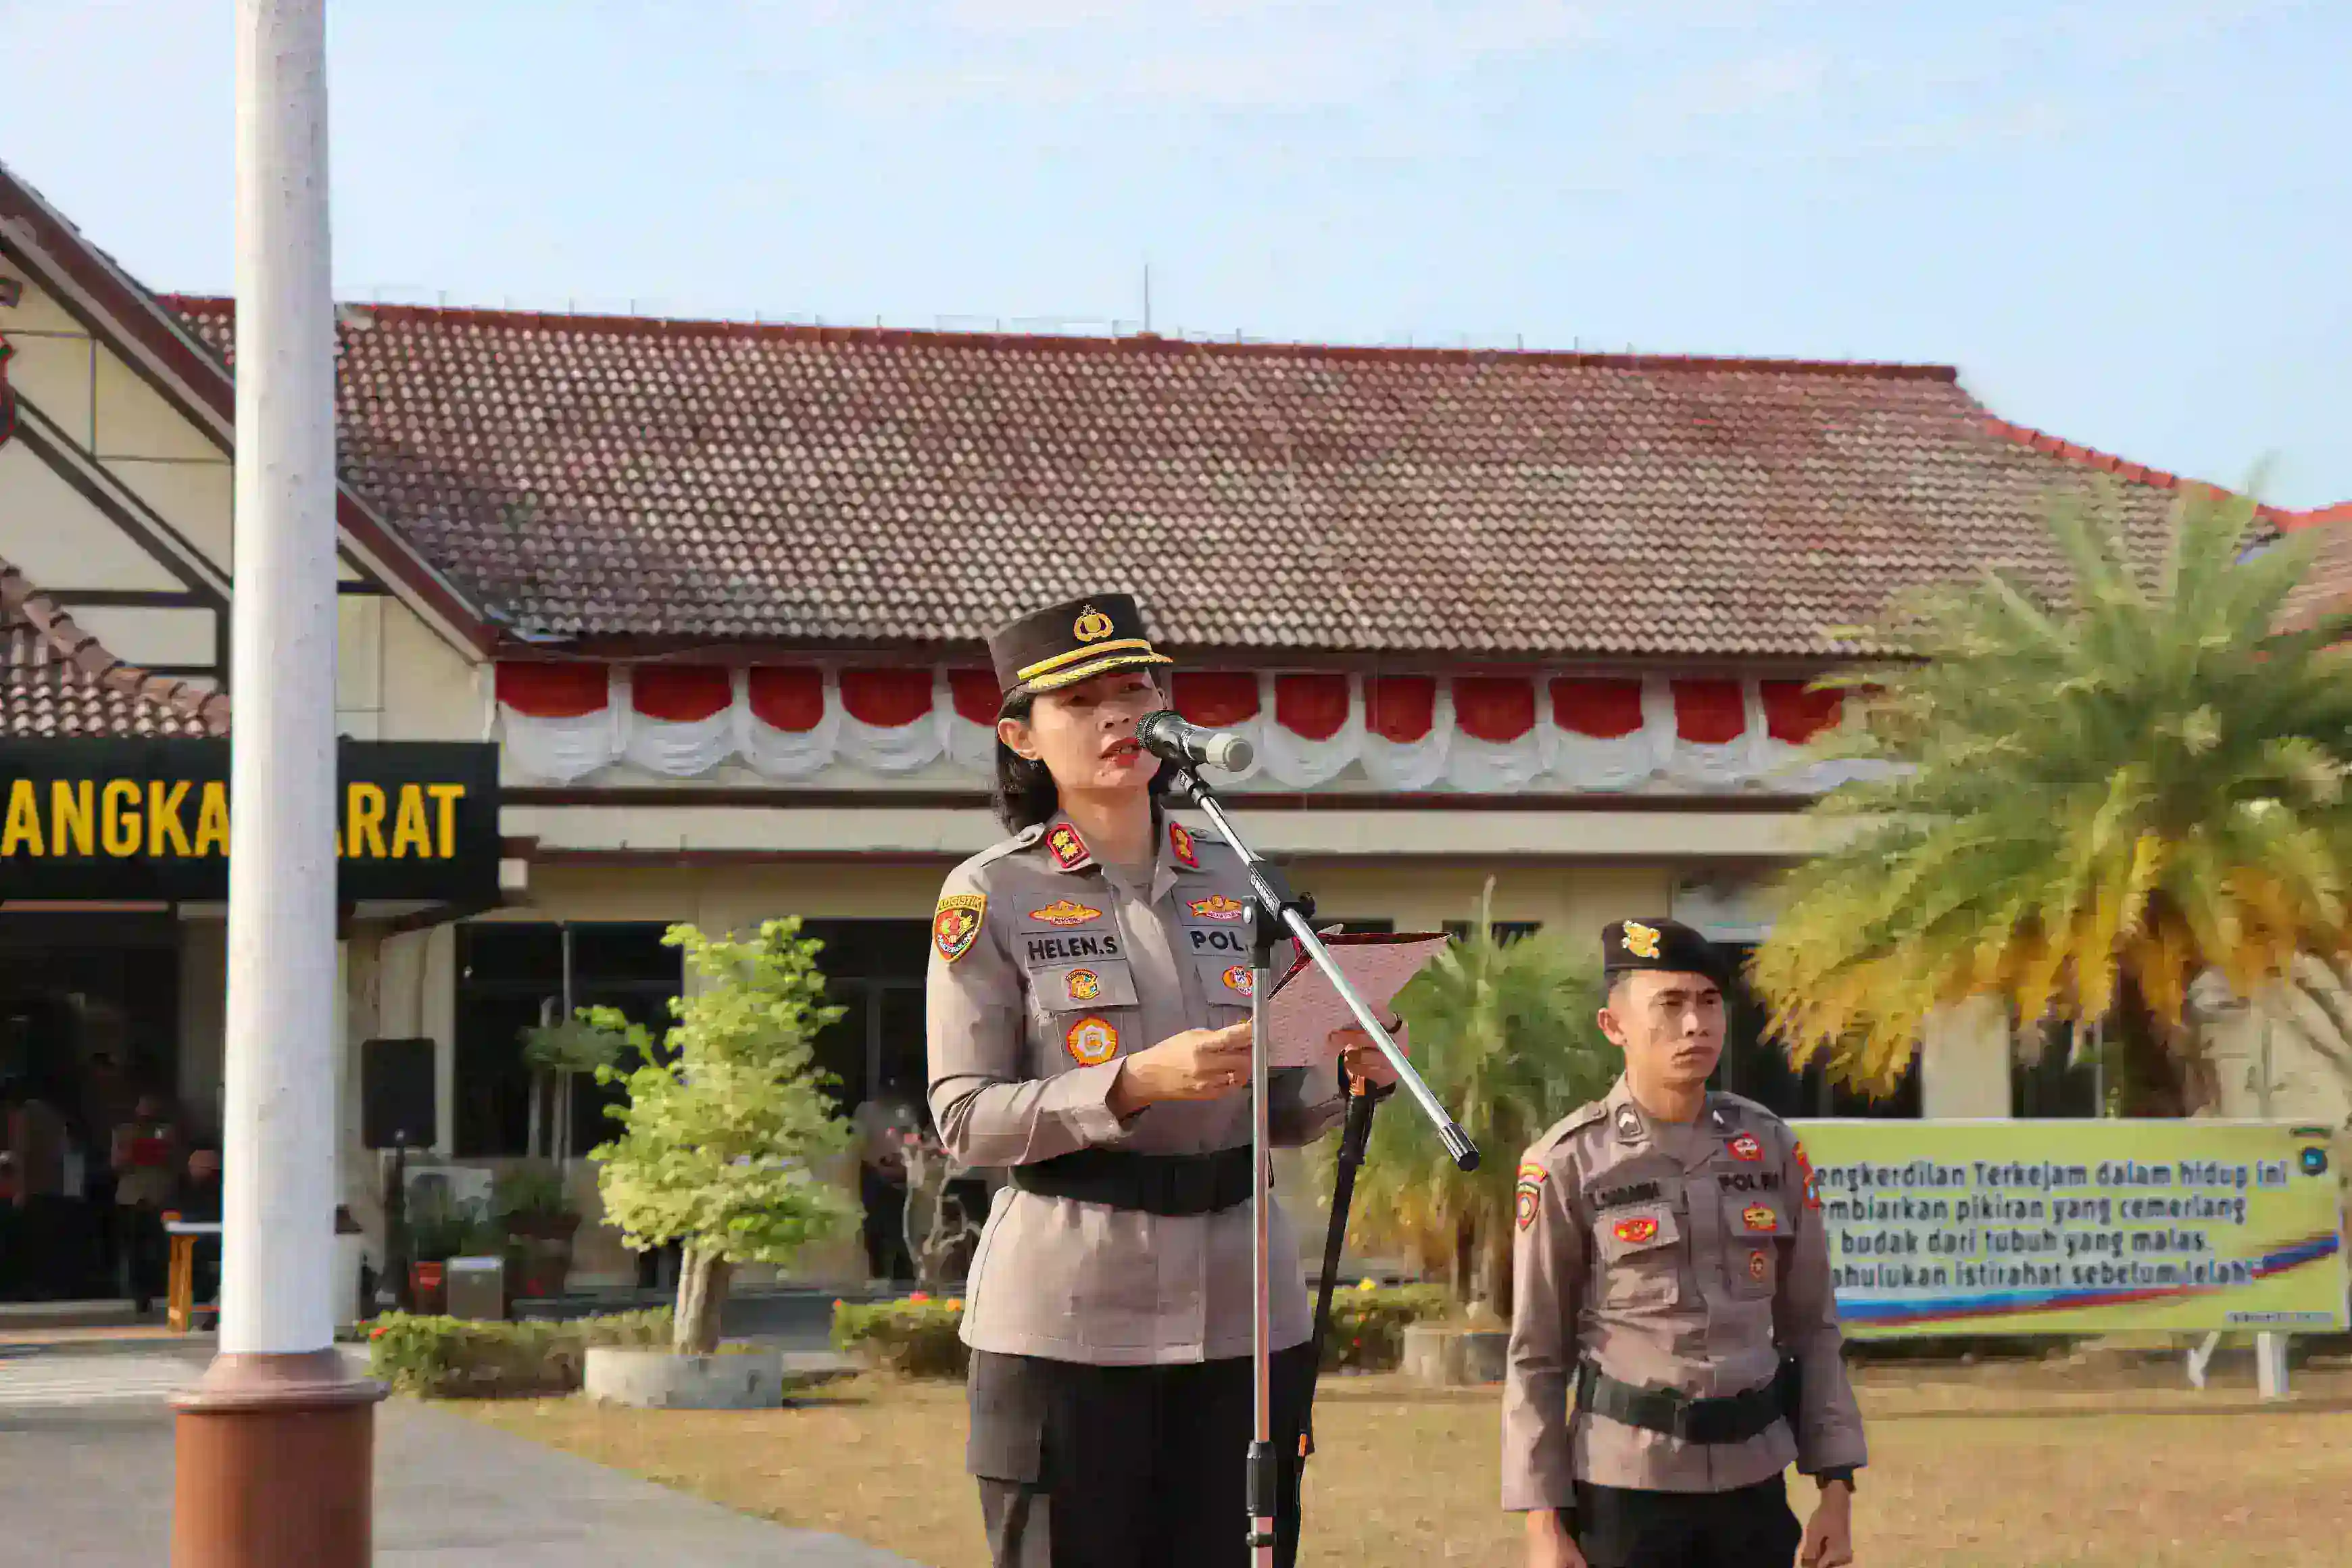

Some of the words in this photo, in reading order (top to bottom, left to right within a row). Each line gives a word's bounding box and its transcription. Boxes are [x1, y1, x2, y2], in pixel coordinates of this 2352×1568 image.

[335, 782, 466, 858] RAT
[1027, 935, 1119, 960] HELEN.S
[1190, 931, 1245, 951] POL
[2096, 1160, 2172, 1185] dalam
[1957, 1194, 2044, 1224] pikiran
[2053, 1200, 2111, 1226] yang
[1841, 1228, 1919, 1254] budak
[1928, 1227, 1976, 1254] dari
[2064, 1232, 2123, 1259] yang
[1956, 1260, 2061, 1287] istirahat
